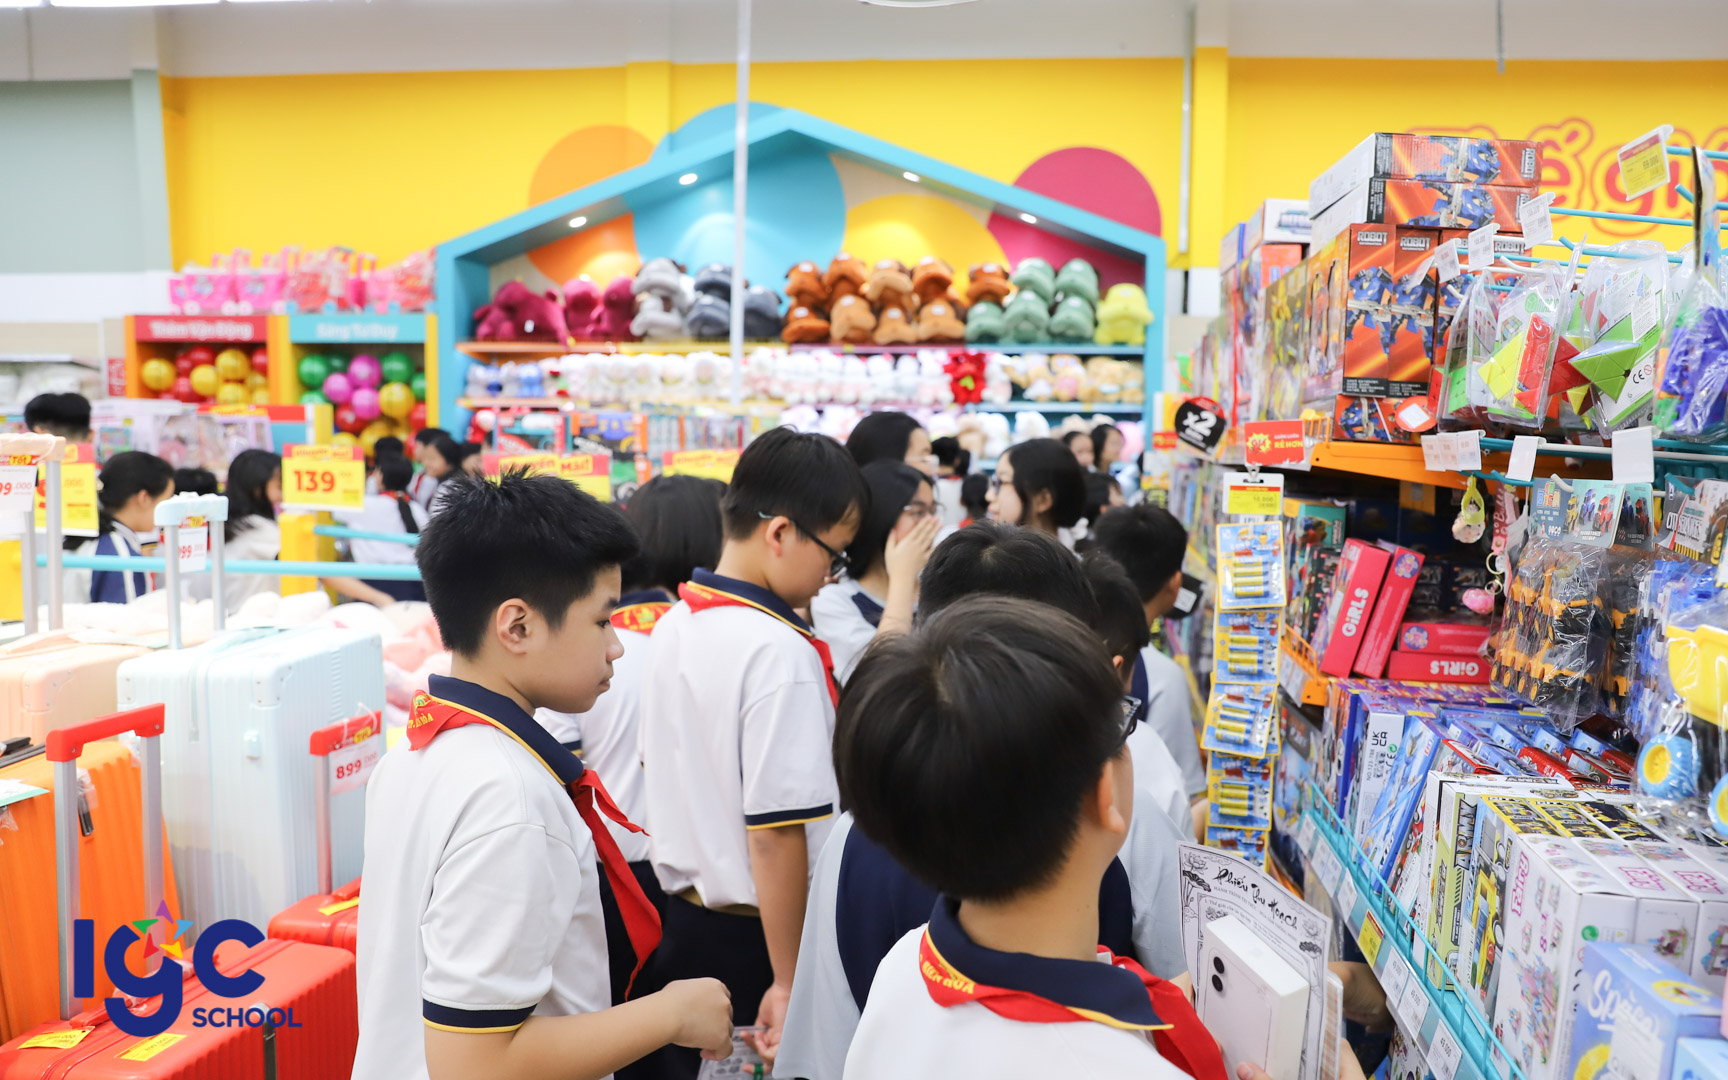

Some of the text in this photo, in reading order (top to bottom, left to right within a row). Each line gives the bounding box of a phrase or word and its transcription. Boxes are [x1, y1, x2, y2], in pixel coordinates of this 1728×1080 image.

[1520, 147, 1536, 179] ROBOT
[1357, 231, 1388, 246] ROBOT
[1400, 237, 1430, 251] ROBOT
[1495, 241, 1525, 255] ROBOT
[293, 470, 335, 493] 139
[336, 759, 362, 780] 899
[1454, 798, 1477, 871] ARMY
